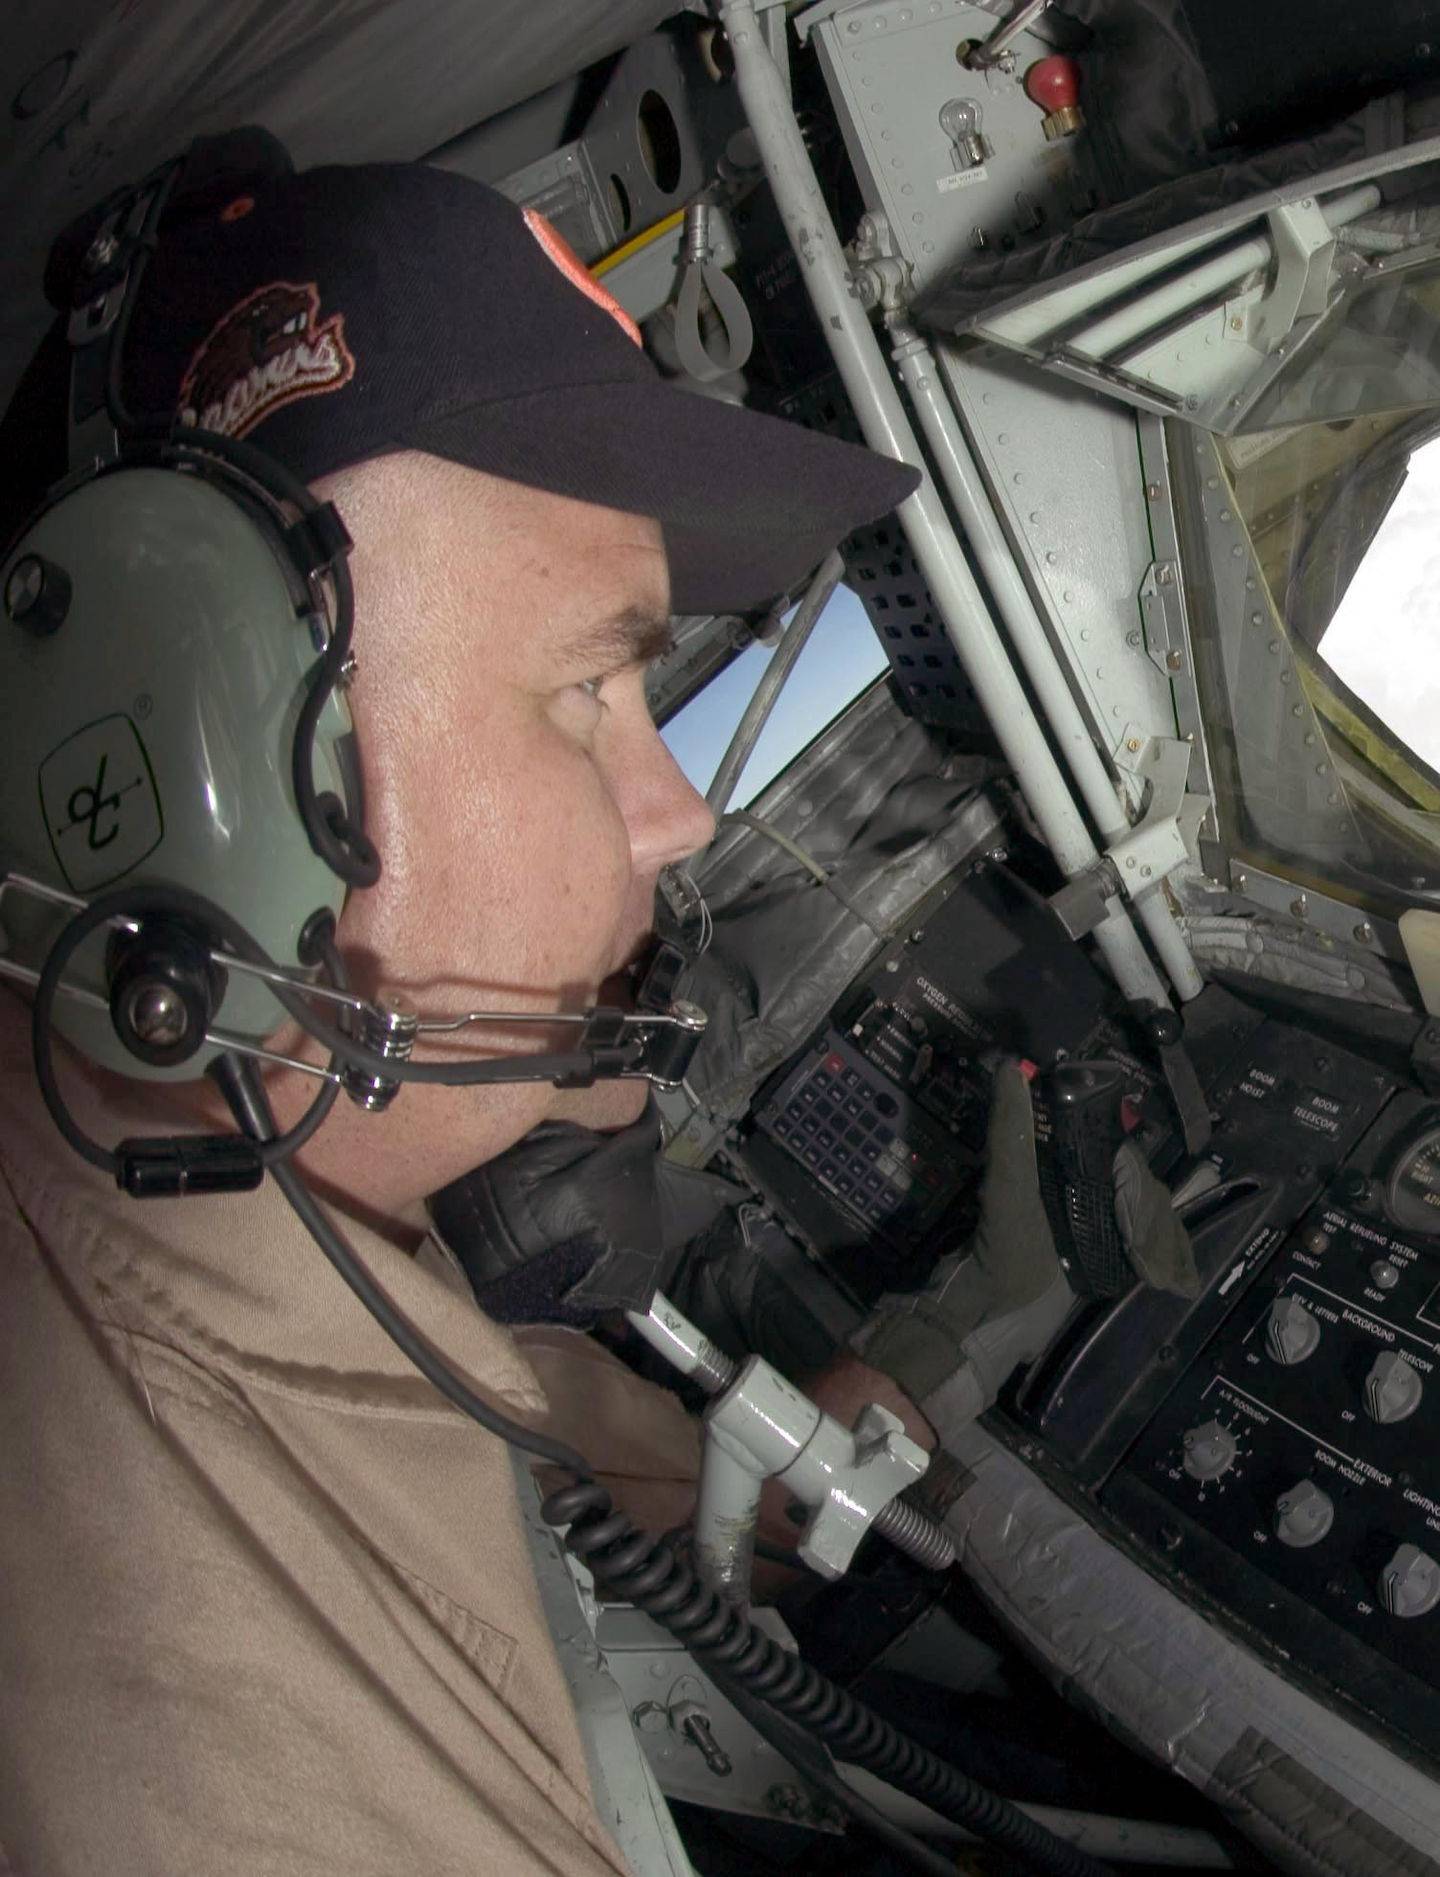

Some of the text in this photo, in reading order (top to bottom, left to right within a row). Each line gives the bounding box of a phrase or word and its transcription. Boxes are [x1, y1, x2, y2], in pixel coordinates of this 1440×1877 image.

[1312, 1096, 1340, 1114] BOOM
[1293, 1106, 1339, 1132] TELESCOPE
[1292, 1251, 1322, 1271] CONTACT
[1389, 1241, 1420, 1262] SYSTEM
[1342, 1310, 1396, 1342] BACKGROUND
[1341, 1409, 1356, 1422] OFF
[1315, 1449, 1368, 1487] BOOM NOZZLE
[1353, 1458, 1393, 1488] EXTERIOR
[1253, 1530, 1268, 1543] OFF
[1356, 1601, 1374, 1616] OFF
